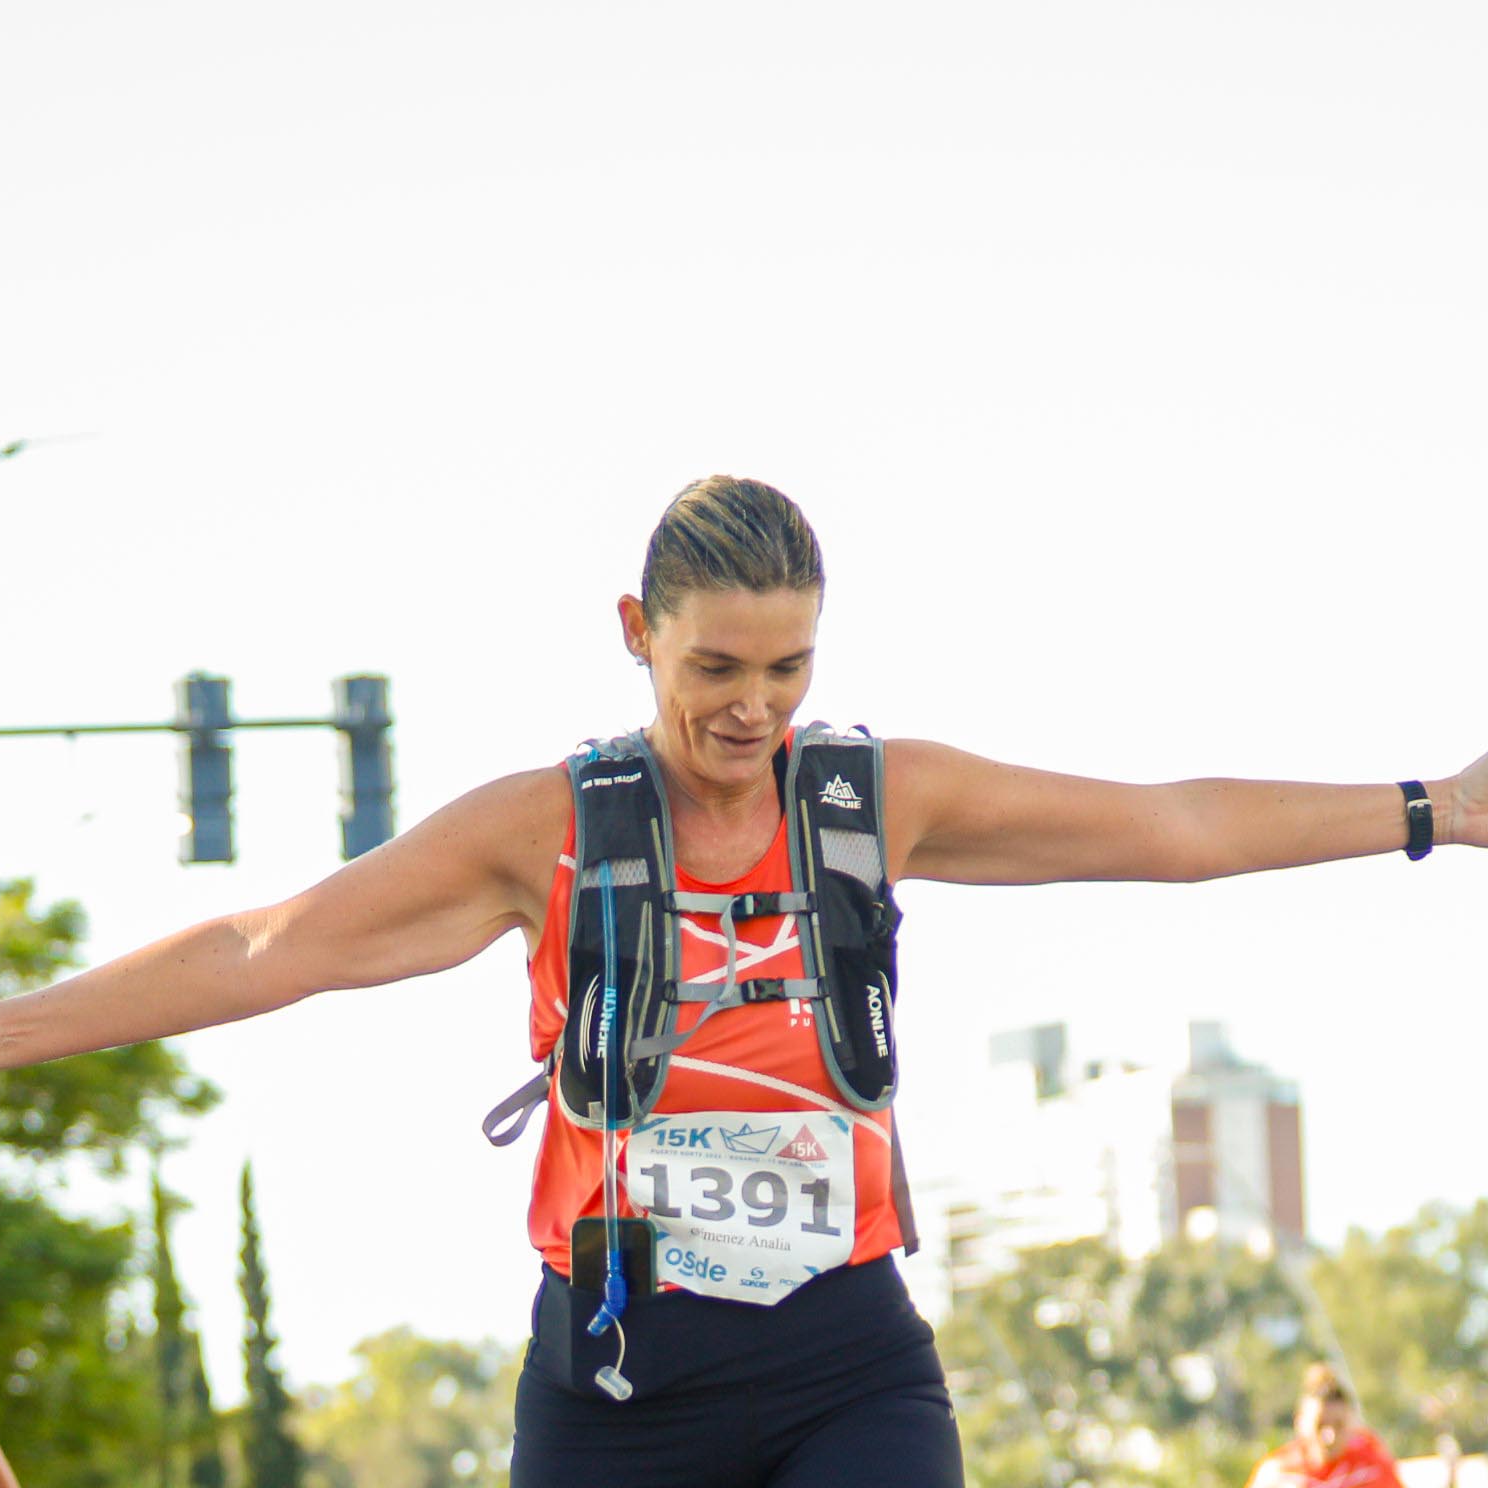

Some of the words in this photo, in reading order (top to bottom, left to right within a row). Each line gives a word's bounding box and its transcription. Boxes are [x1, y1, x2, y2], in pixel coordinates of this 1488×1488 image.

[865, 984, 889, 1059] AONIJIE
[653, 1125, 714, 1150] 15K
[790, 1141, 818, 1158] 15K
[640, 1163, 841, 1237] 1391
[665, 1247, 727, 1283] osde
